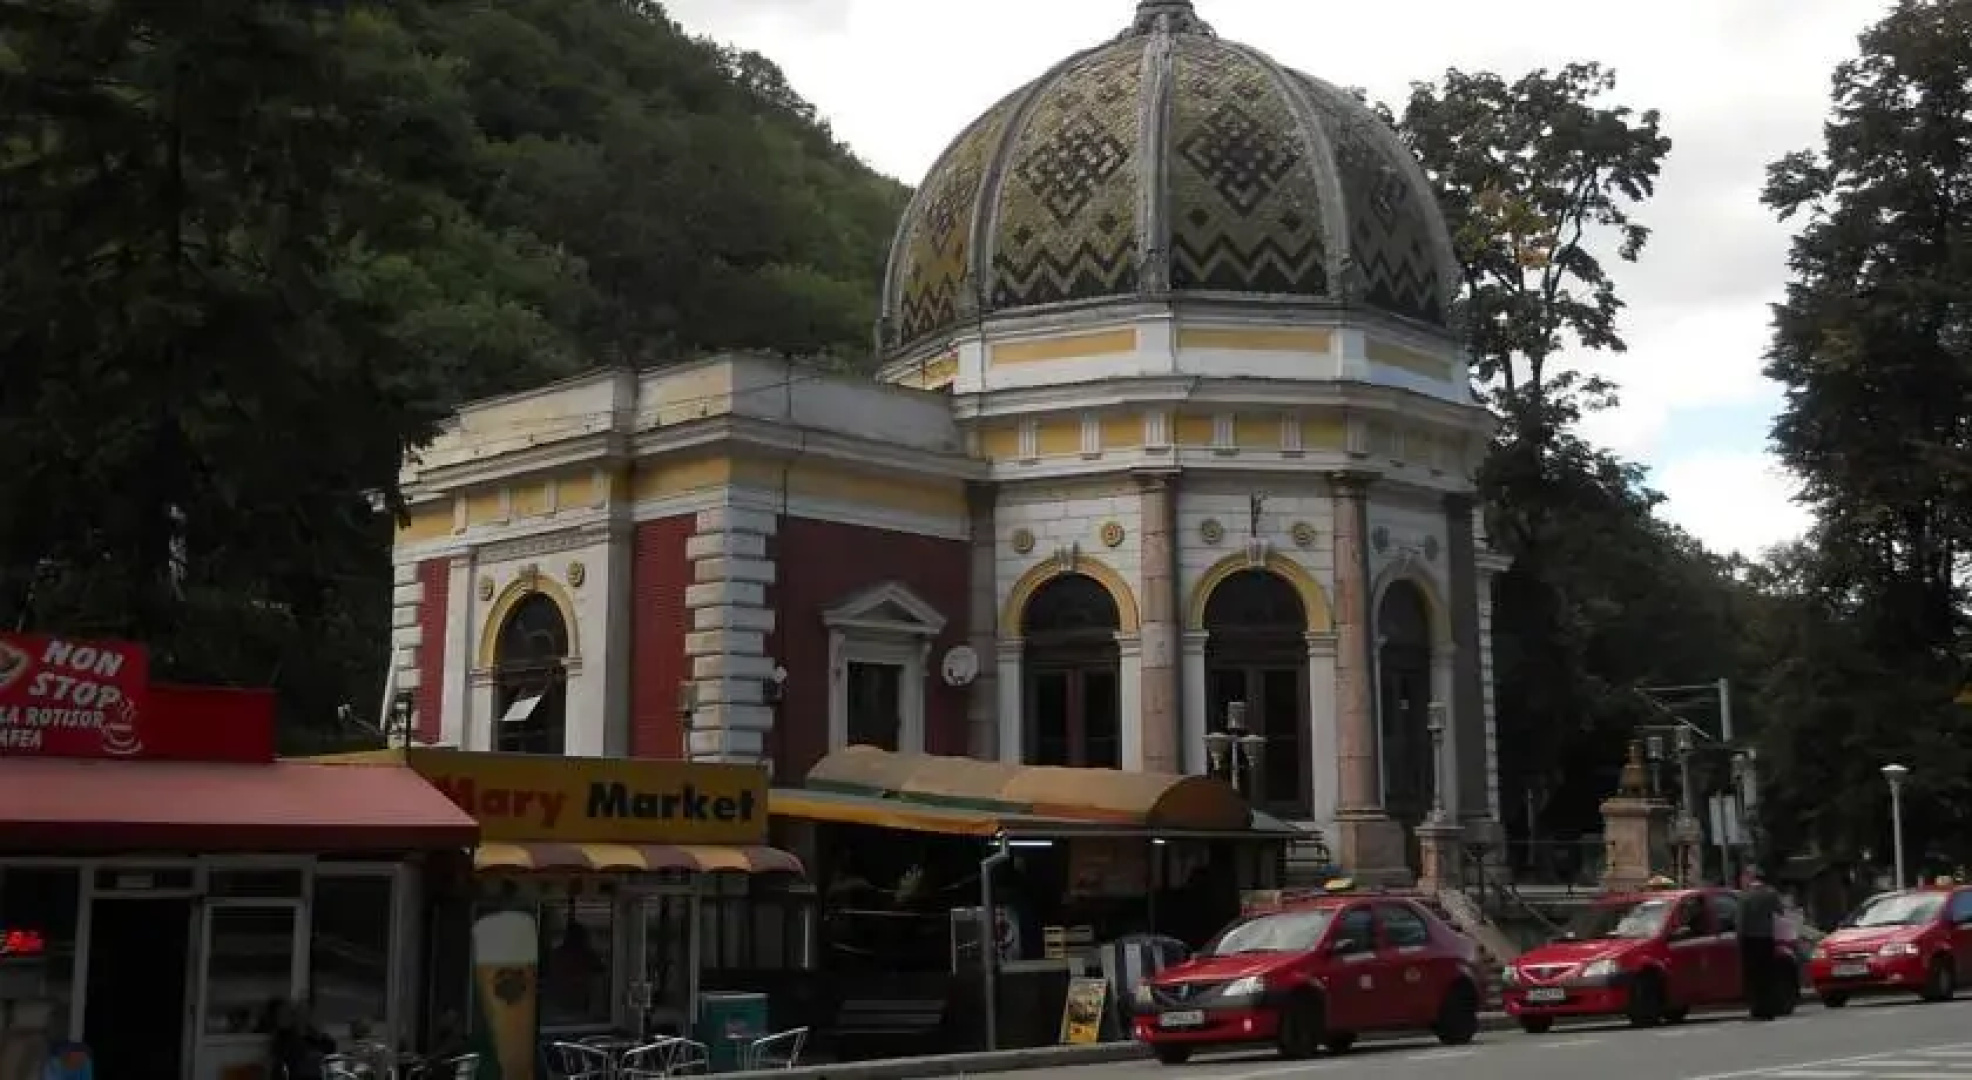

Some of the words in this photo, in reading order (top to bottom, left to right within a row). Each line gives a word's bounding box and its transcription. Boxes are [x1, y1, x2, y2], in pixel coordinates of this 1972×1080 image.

[40, 639, 124, 677] NON
[27, 672, 122, 707] STOP
[586, 780, 756, 822] Market
